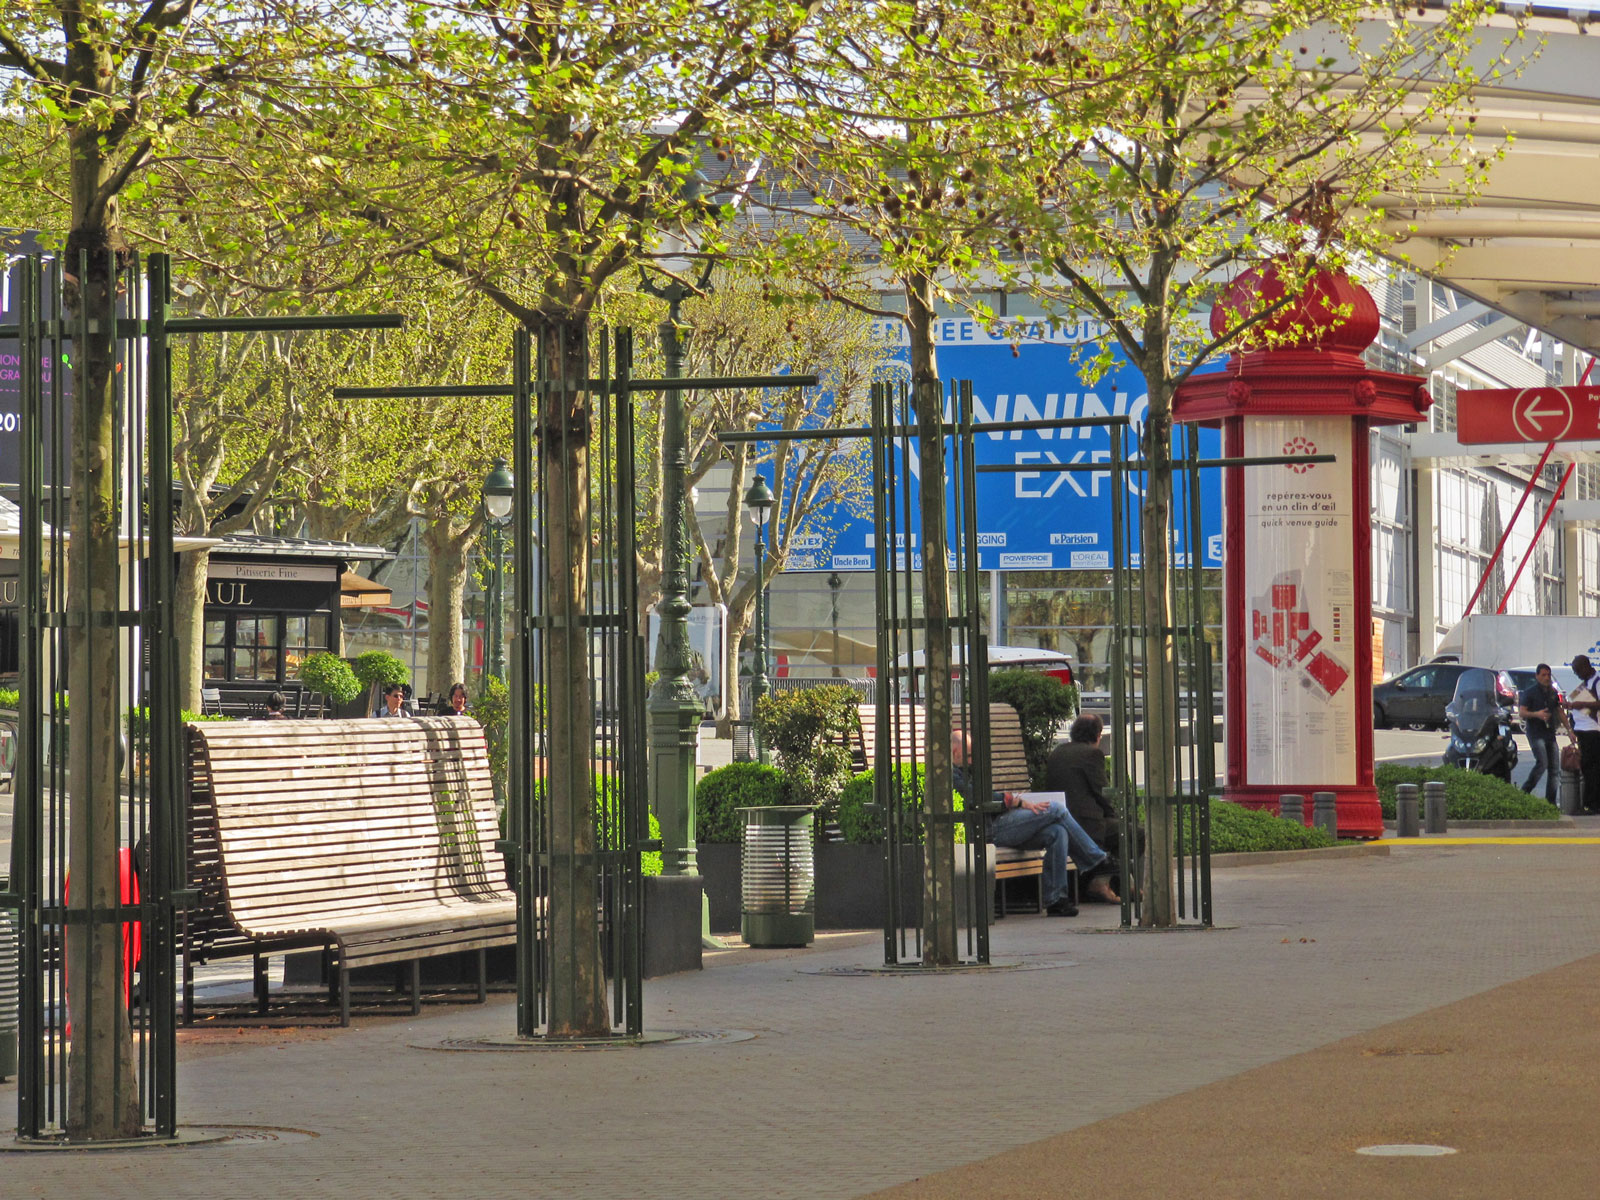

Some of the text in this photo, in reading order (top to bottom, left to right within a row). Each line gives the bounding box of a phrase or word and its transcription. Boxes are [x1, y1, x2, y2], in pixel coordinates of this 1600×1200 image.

[1267, 492, 1332, 501] repérez-vous
[1292, 502, 1308, 511] clin
[1261, 519, 1283, 528] quick
[1315, 518, 1338, 528] guide
[834, 557, 852, 566] Uncle
[236, 566, 298, 579] Pâtisserie Fine
